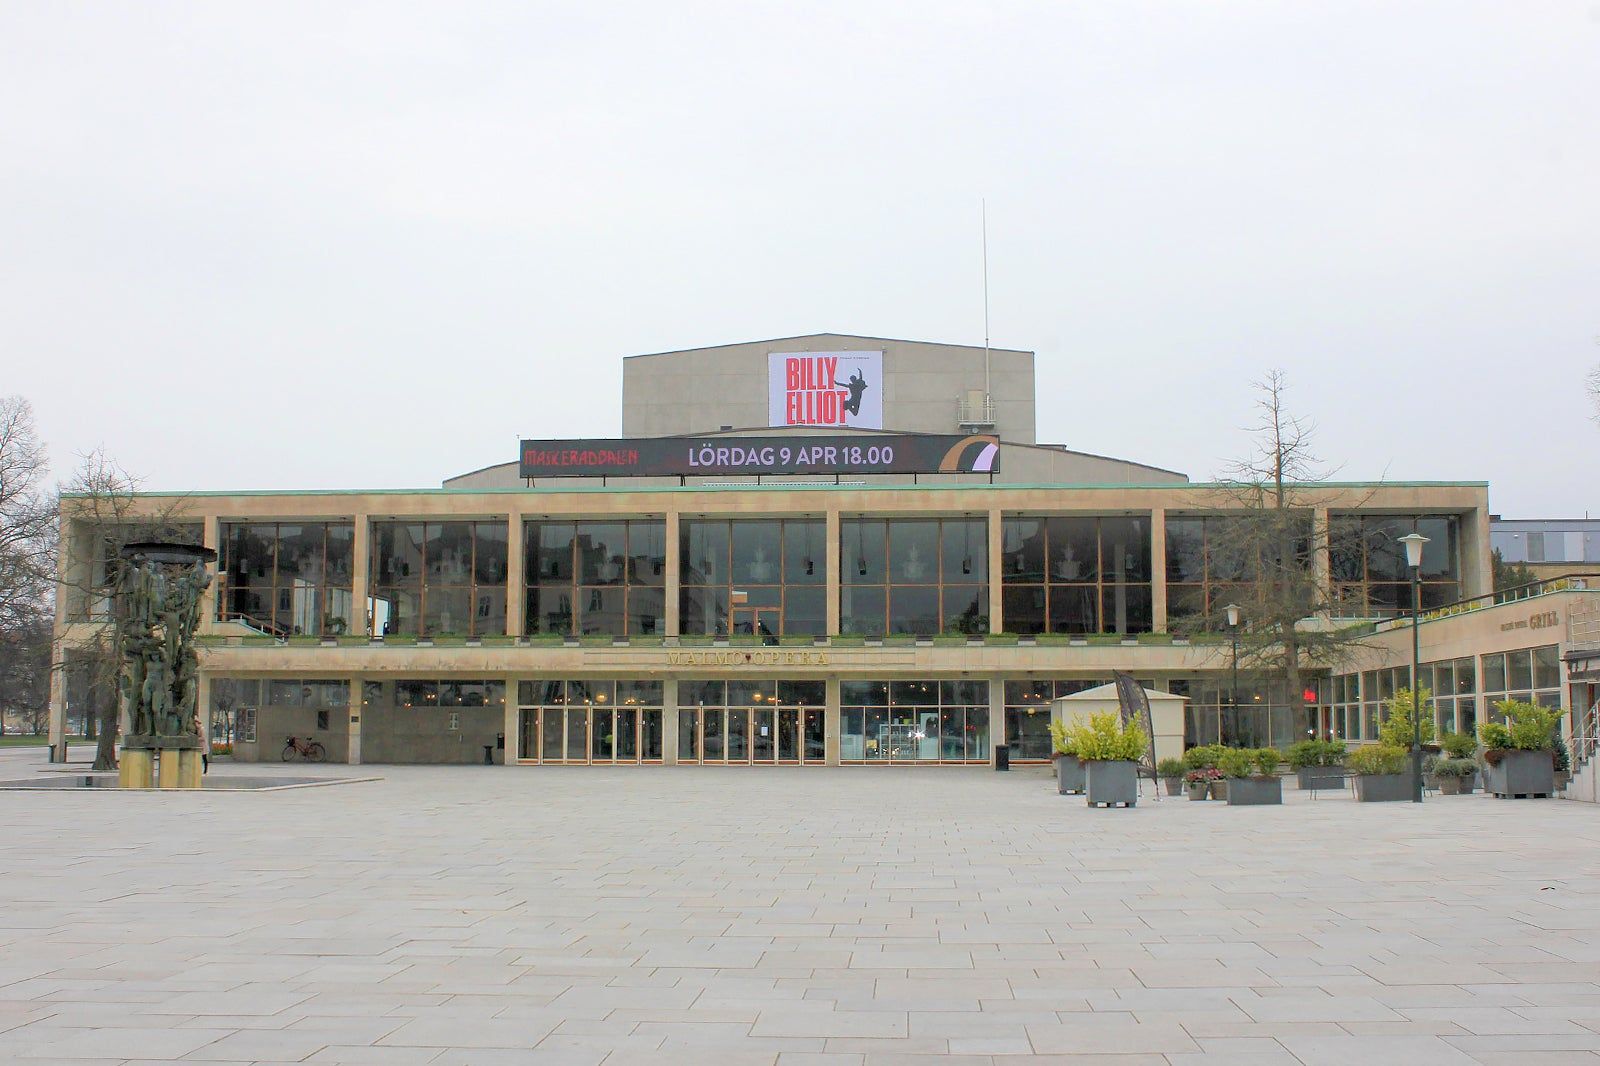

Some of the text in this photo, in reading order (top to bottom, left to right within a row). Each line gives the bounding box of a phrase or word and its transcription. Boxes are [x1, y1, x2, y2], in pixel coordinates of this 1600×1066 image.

[786, 357, 838, 390] BILLY
[786, 391, 848, 424] ELLIOT
[689, 443, 894, 466] LÖRDAG 9 APR 18.00
[754, 650, 831, 665] OPERA
